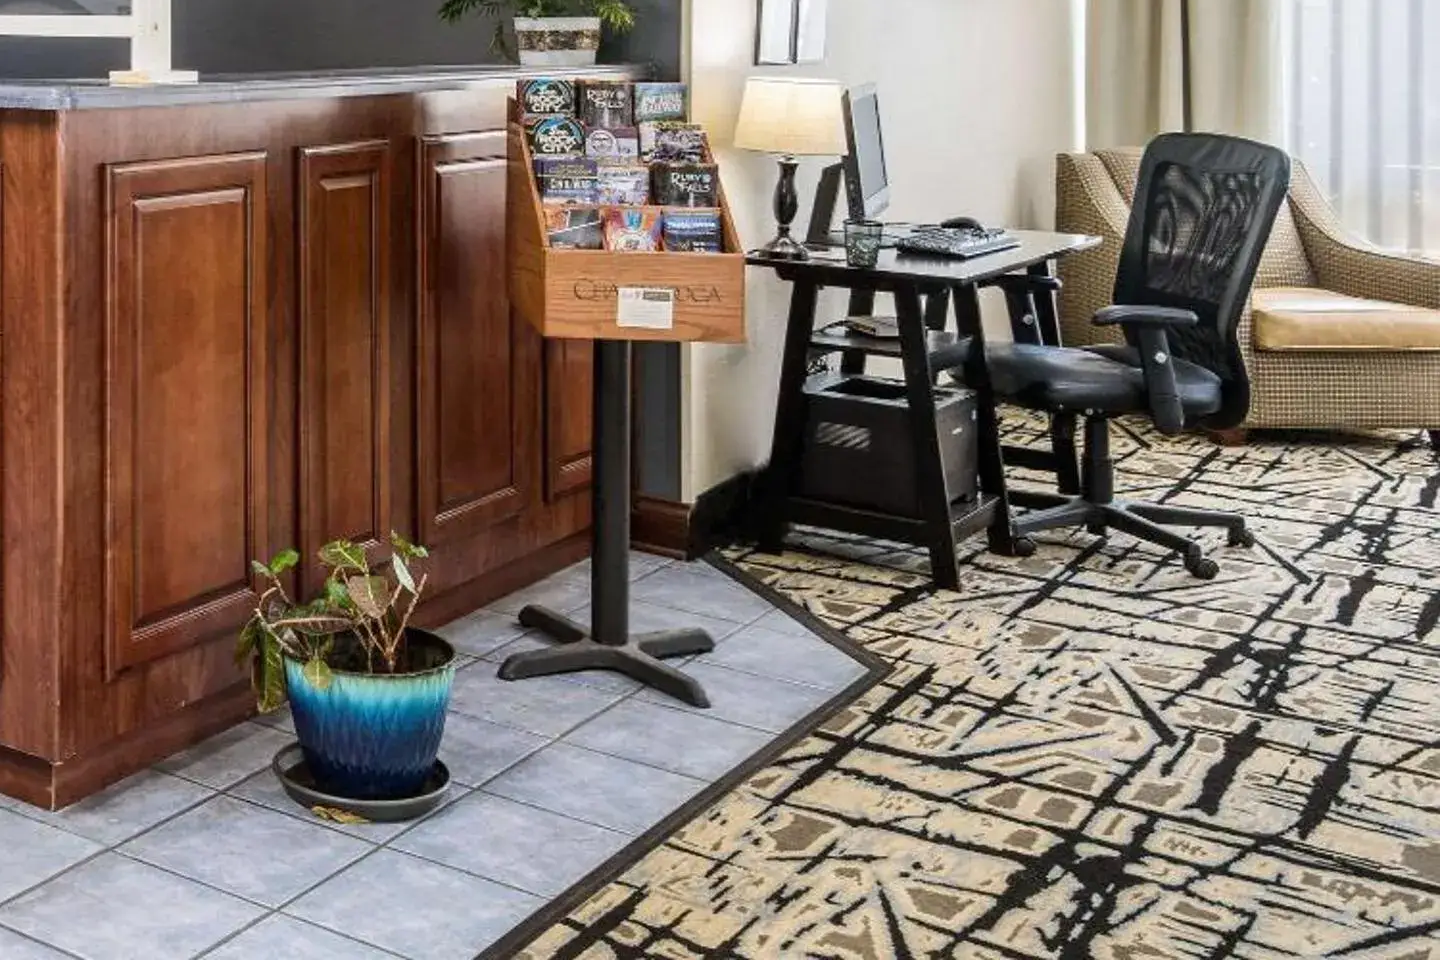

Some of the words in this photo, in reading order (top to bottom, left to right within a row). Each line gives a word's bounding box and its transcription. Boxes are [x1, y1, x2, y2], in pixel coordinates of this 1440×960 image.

[529, 95, 566, 105] ROCK
[532, 103, 561, 112] CITY
[538, 136, 577, 146] ROCK
[542, 144, 573, 153] CITY
